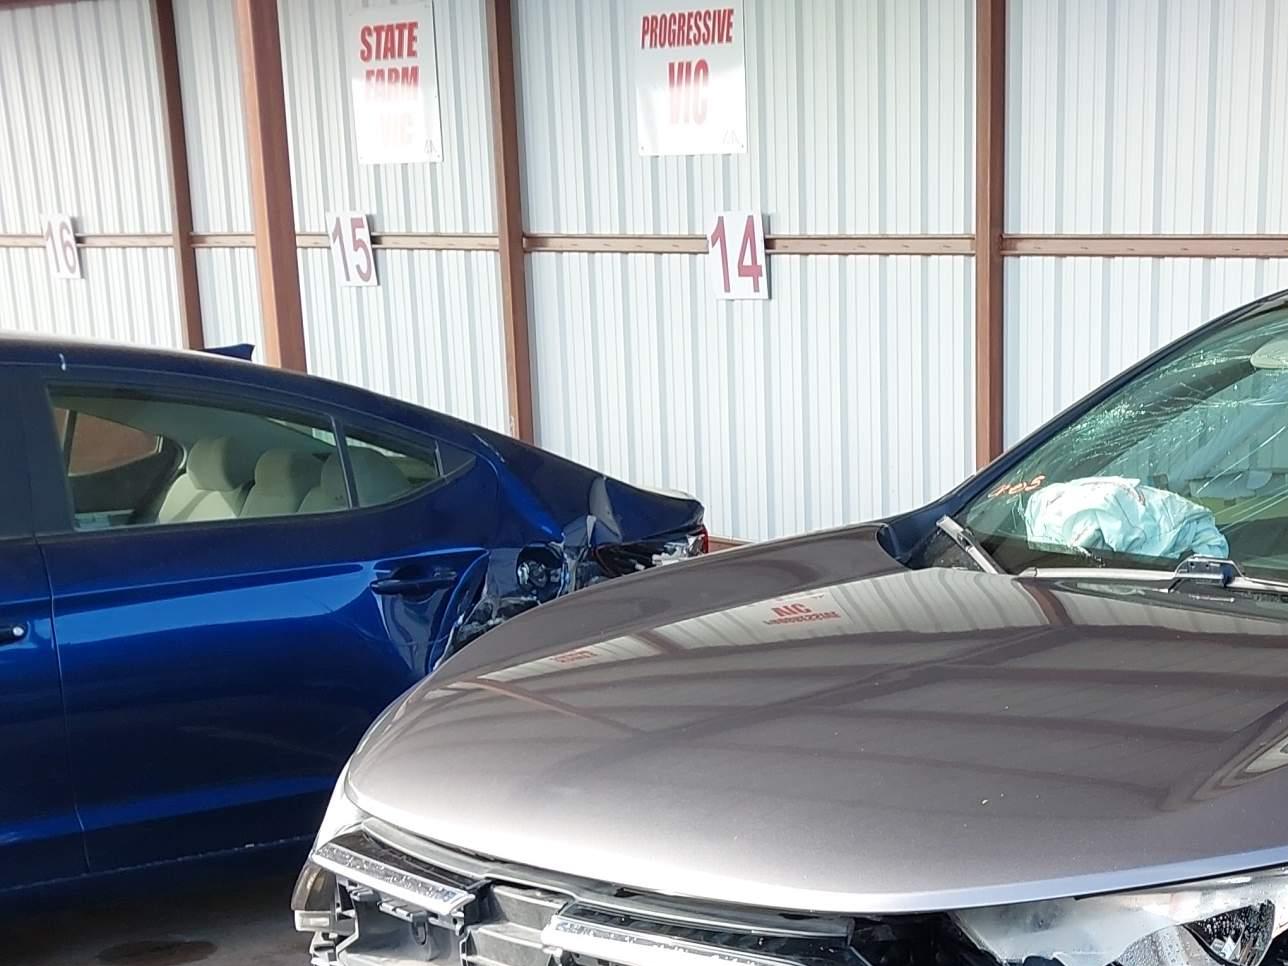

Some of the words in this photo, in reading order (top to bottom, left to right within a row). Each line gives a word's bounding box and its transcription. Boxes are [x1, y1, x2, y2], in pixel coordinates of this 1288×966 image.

[360, 21, 419, 63] STATE
[641, 8, 734, 50] PROGRESSIVE
[668, 58, 709, 125] VIC
[45, 220, 77, 274] 16
[332, 216, 372, 282] 15
[711, 215, 763, 293] 14
